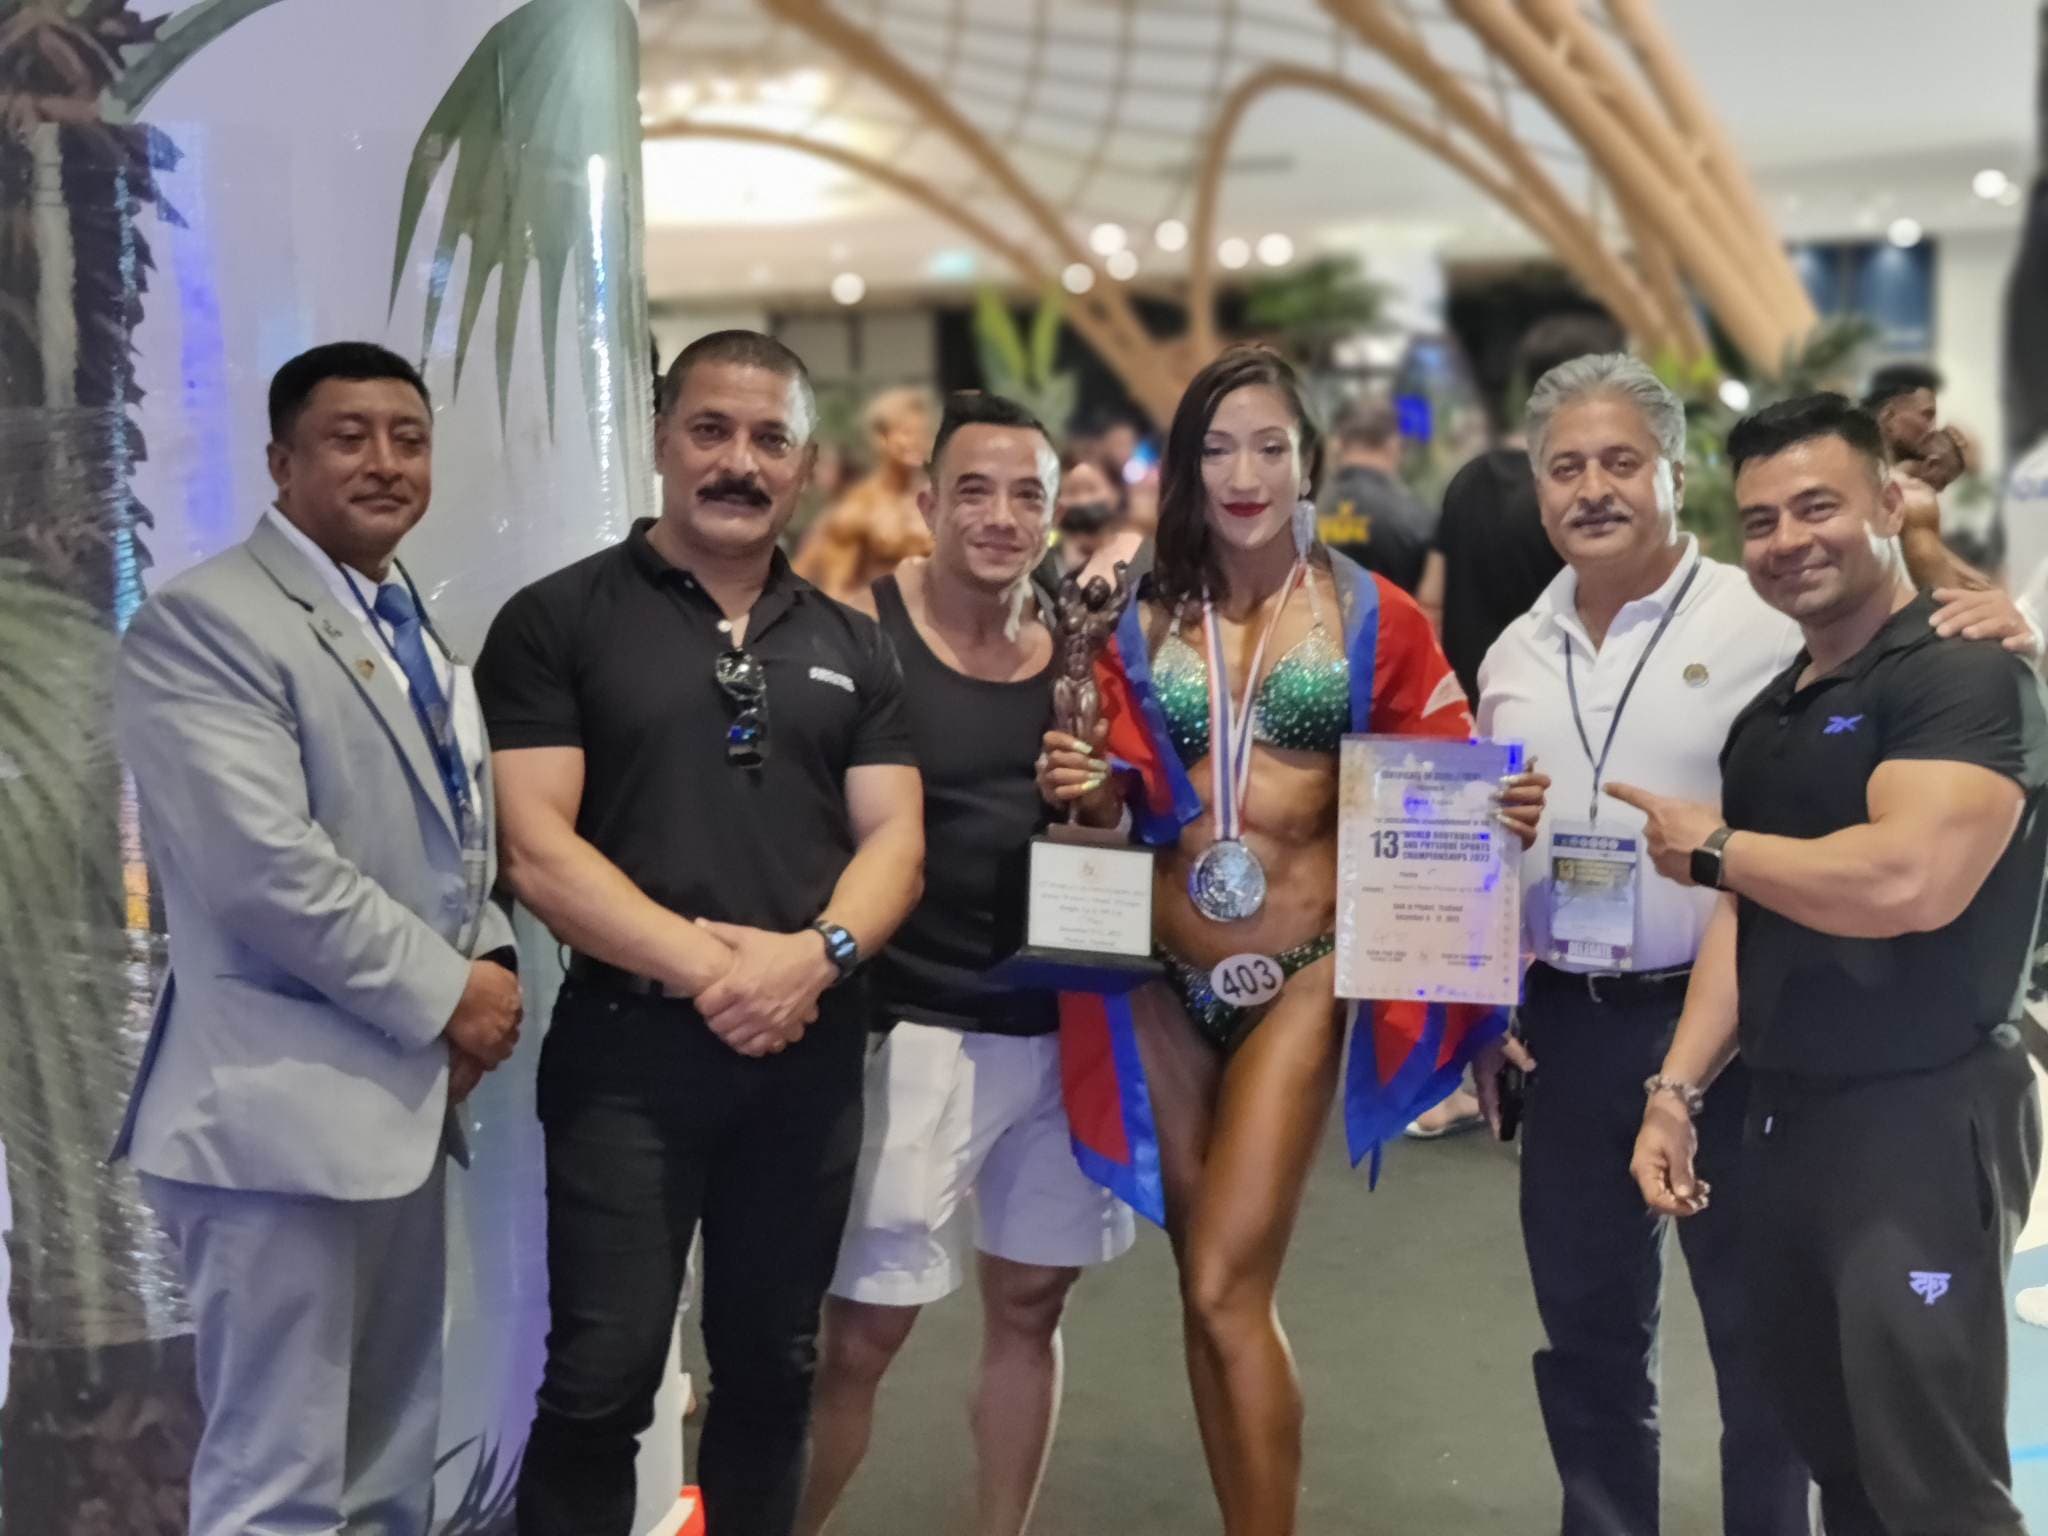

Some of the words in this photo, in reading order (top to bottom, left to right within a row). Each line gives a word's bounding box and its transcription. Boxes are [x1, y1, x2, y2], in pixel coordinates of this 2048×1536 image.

[1403, 831, 1431, 839] WORLD
[1369, 830, 1399, 859] 13
[1403, 841, 1418, 849] AND
[1420, 841, 1457, 850] PHYSIQUE
[1460, 842, 1491, 852] SPORTS
[1403, 852, 1467, 862] CHAMPIONSHIPS
[1568, 941, 1612, 959] DELEGATE
[1222, 959, 1277, 998] 403
